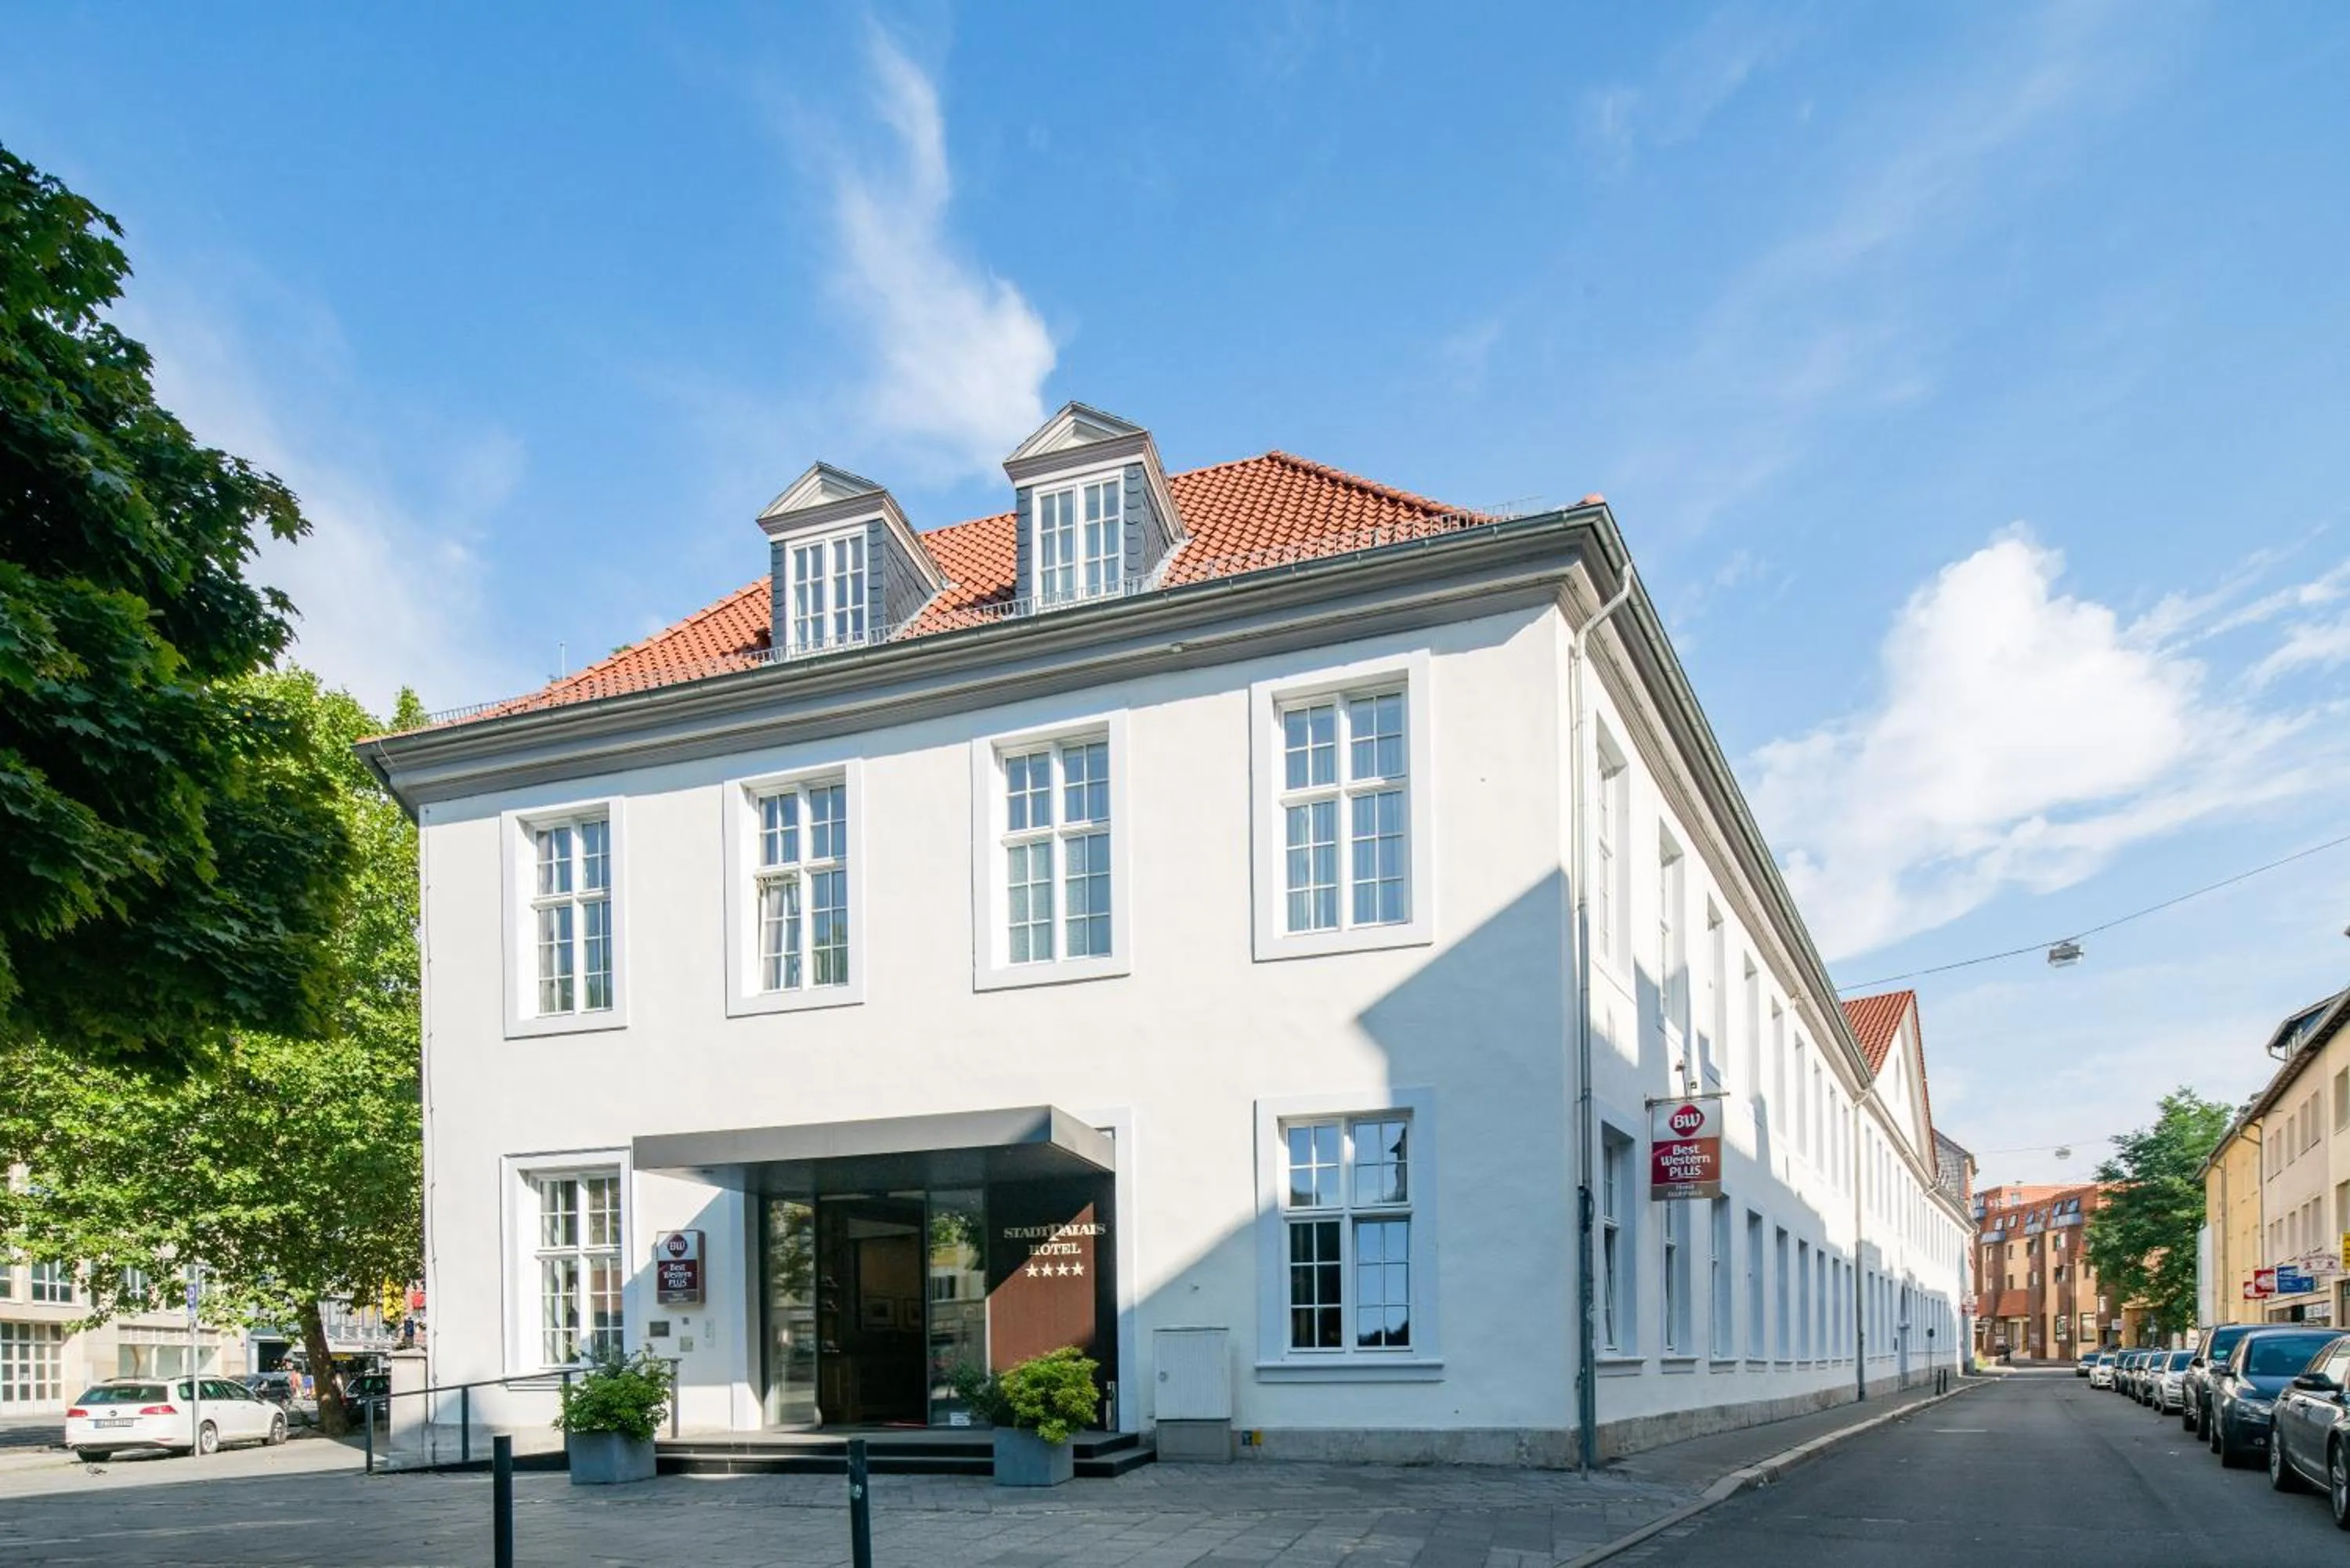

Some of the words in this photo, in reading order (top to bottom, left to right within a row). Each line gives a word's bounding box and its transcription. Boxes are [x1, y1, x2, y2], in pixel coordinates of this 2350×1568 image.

[1673, 1112, 1701, 1129] BW
[1672, 1144, 1701, 1155] Best
[1661, 1154, 1711, 1166] Western
[1669, 1165, 1702, 1176] PLUS
[1029, 1242, 1082, 1255] HOTEL
